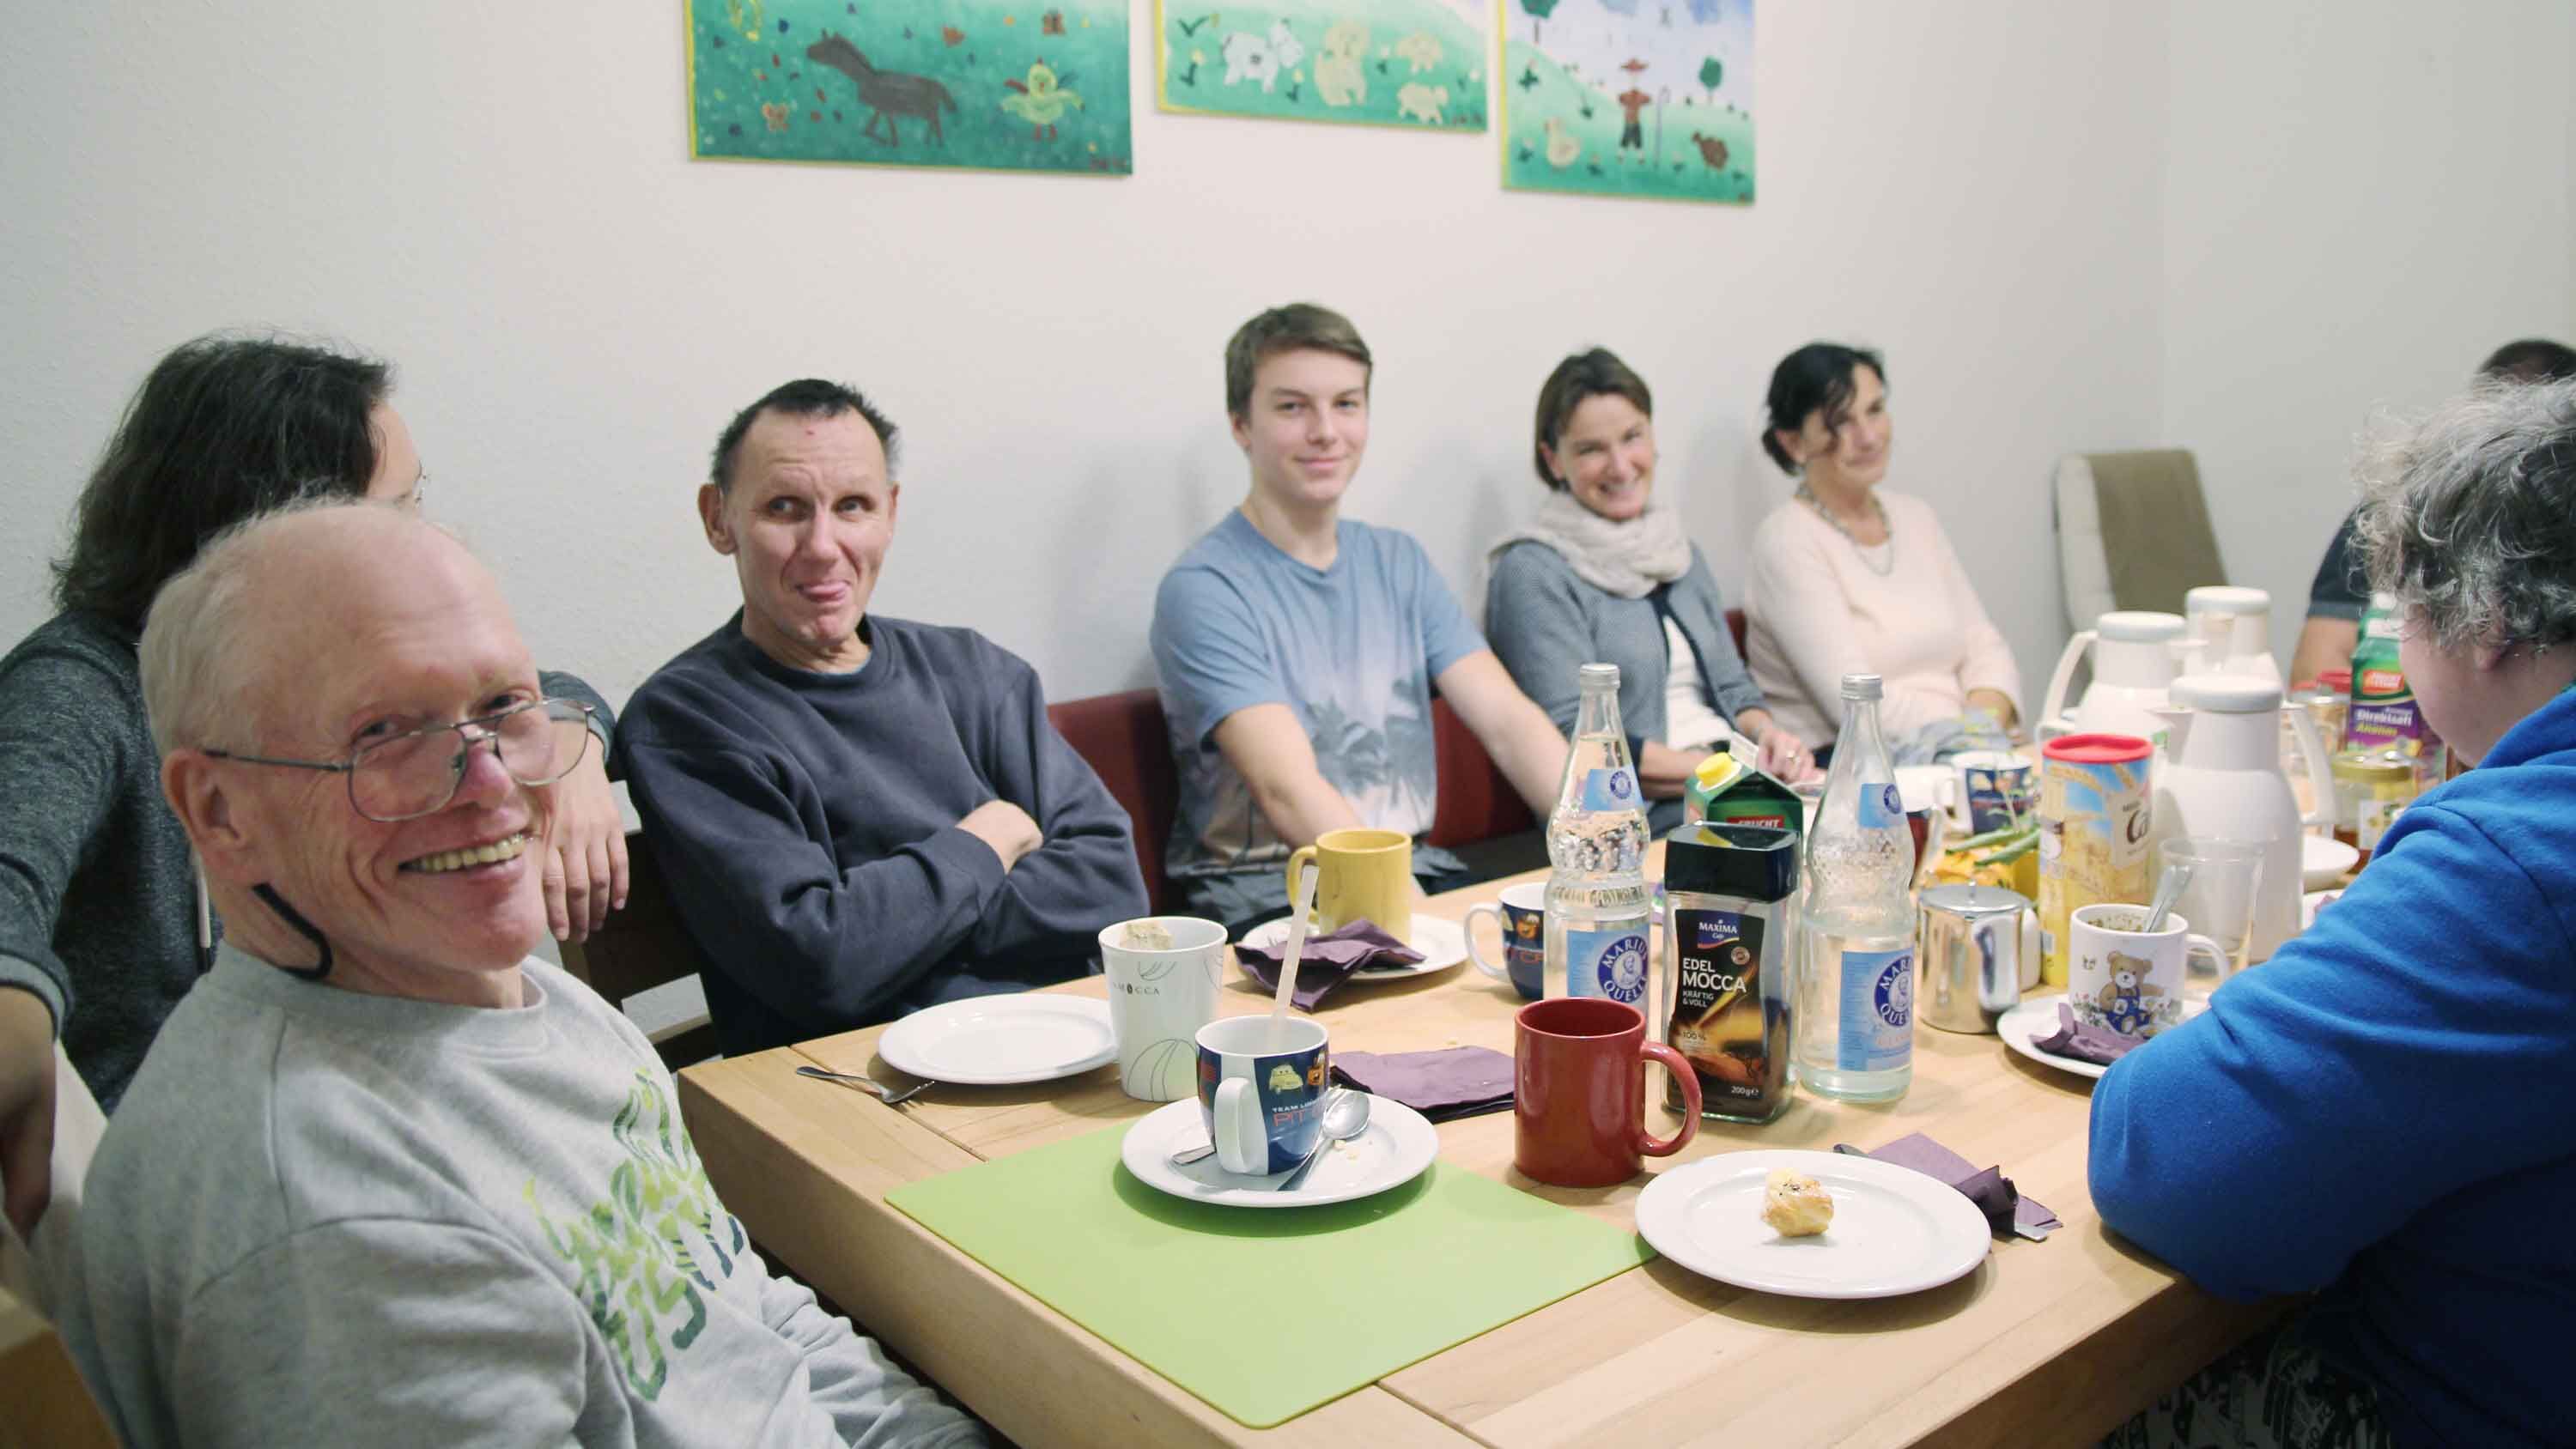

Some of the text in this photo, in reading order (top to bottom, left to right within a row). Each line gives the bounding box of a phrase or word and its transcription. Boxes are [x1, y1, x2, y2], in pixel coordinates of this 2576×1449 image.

[1698, 921, 1738, 934] MAXIMA
[1683, 957, 1716, 973] EDEL
[1683, 970, 1747, 993] MOCCA
